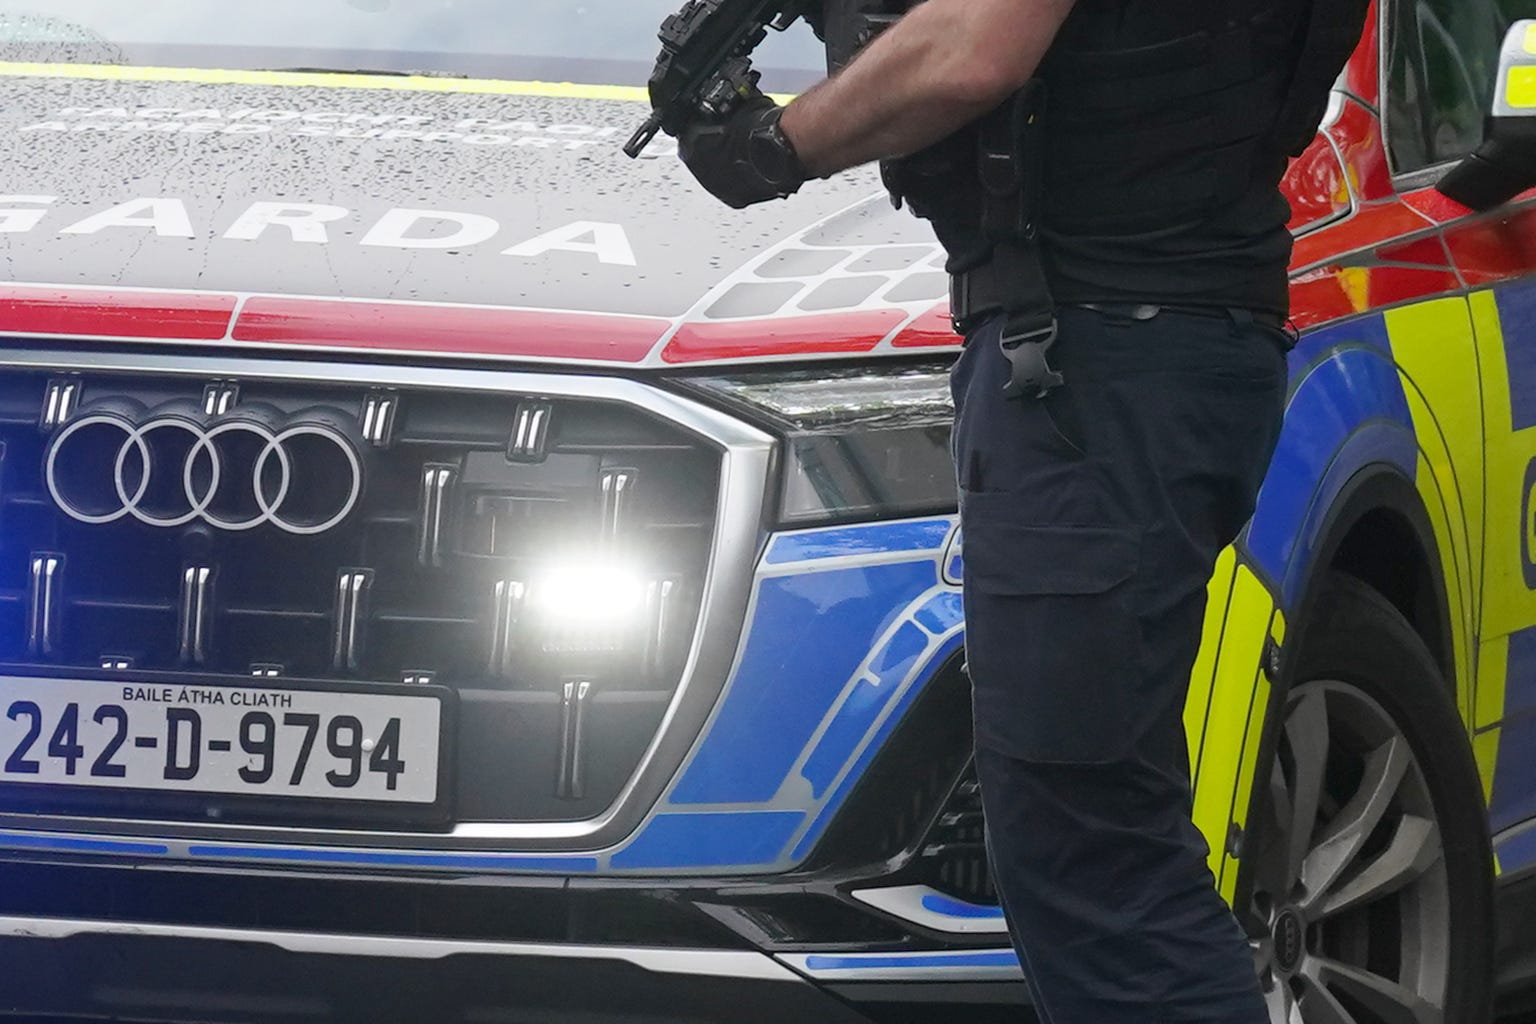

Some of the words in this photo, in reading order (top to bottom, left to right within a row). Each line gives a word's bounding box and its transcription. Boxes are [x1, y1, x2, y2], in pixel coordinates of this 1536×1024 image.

[288, 126, 601, 149] SUPPORT
[123, 686, 173, 703] BAILE
[177, 687, 225, 705] ÁTHA
[230, 691, 293, 709] CLIATH
[4, 700, 406, 791] 242-D-9794
